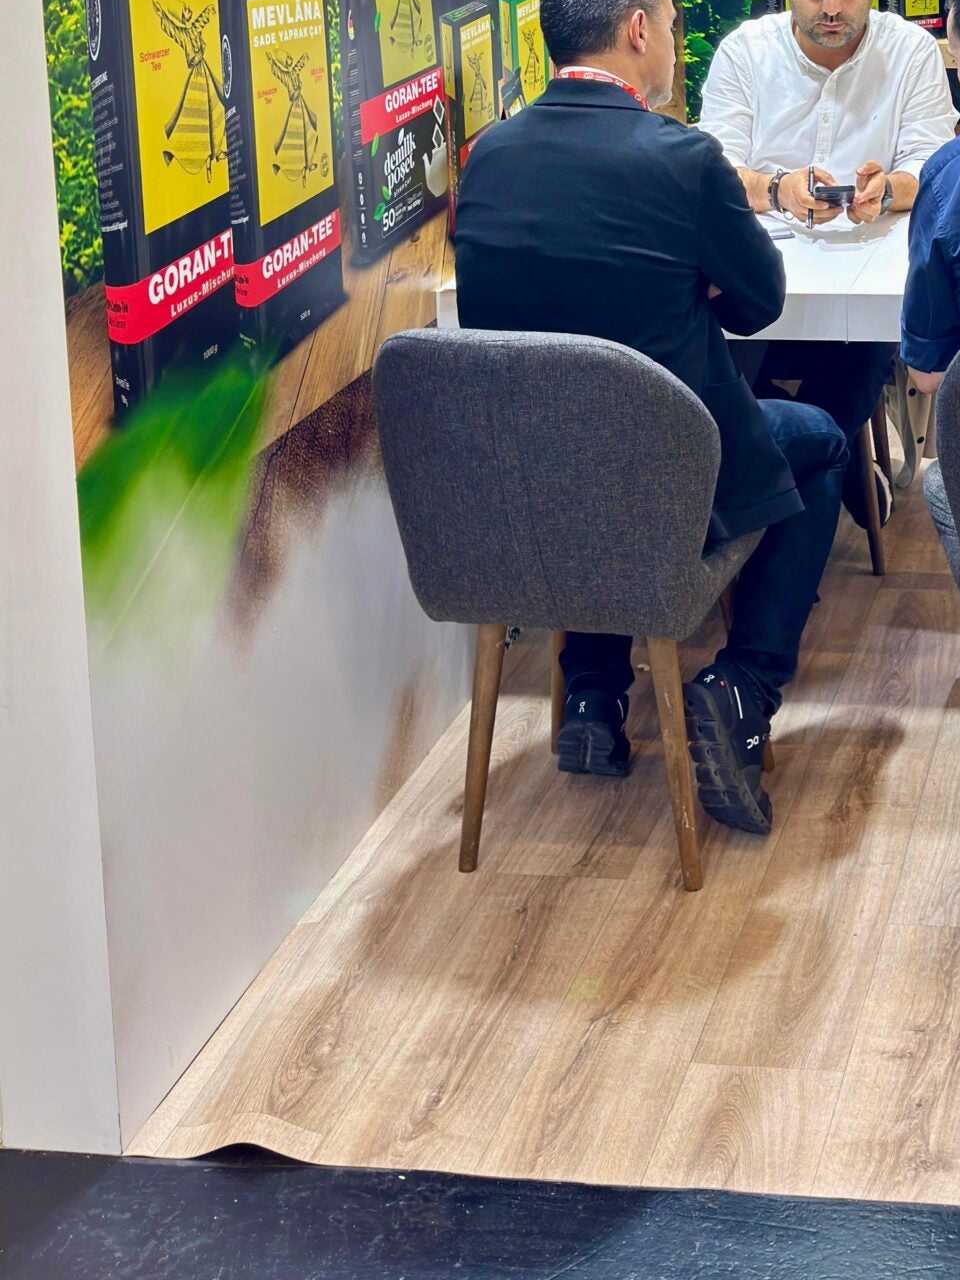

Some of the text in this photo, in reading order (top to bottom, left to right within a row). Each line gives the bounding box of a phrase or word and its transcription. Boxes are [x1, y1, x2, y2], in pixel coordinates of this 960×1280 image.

[251, 0, 322, 30] MEVLÂNA
[253, 23, 323, 48] SADE YAPRAK ÇAY
[139, 47, 171, 64] Schwarzer
[151, 62, 162, 73] Tee
[383, 130, 417, 176] demlik
[387, 151, 416, 196] poşet
[382, 206, 396, 233] 50
[148, 230, 234, 305] GORAN-T
[277, 246, 327, 289] Luxus-Mischung
[170, 266, 235, 317] Luxus-Mischu
[203, 346, 214, 361] 1000
